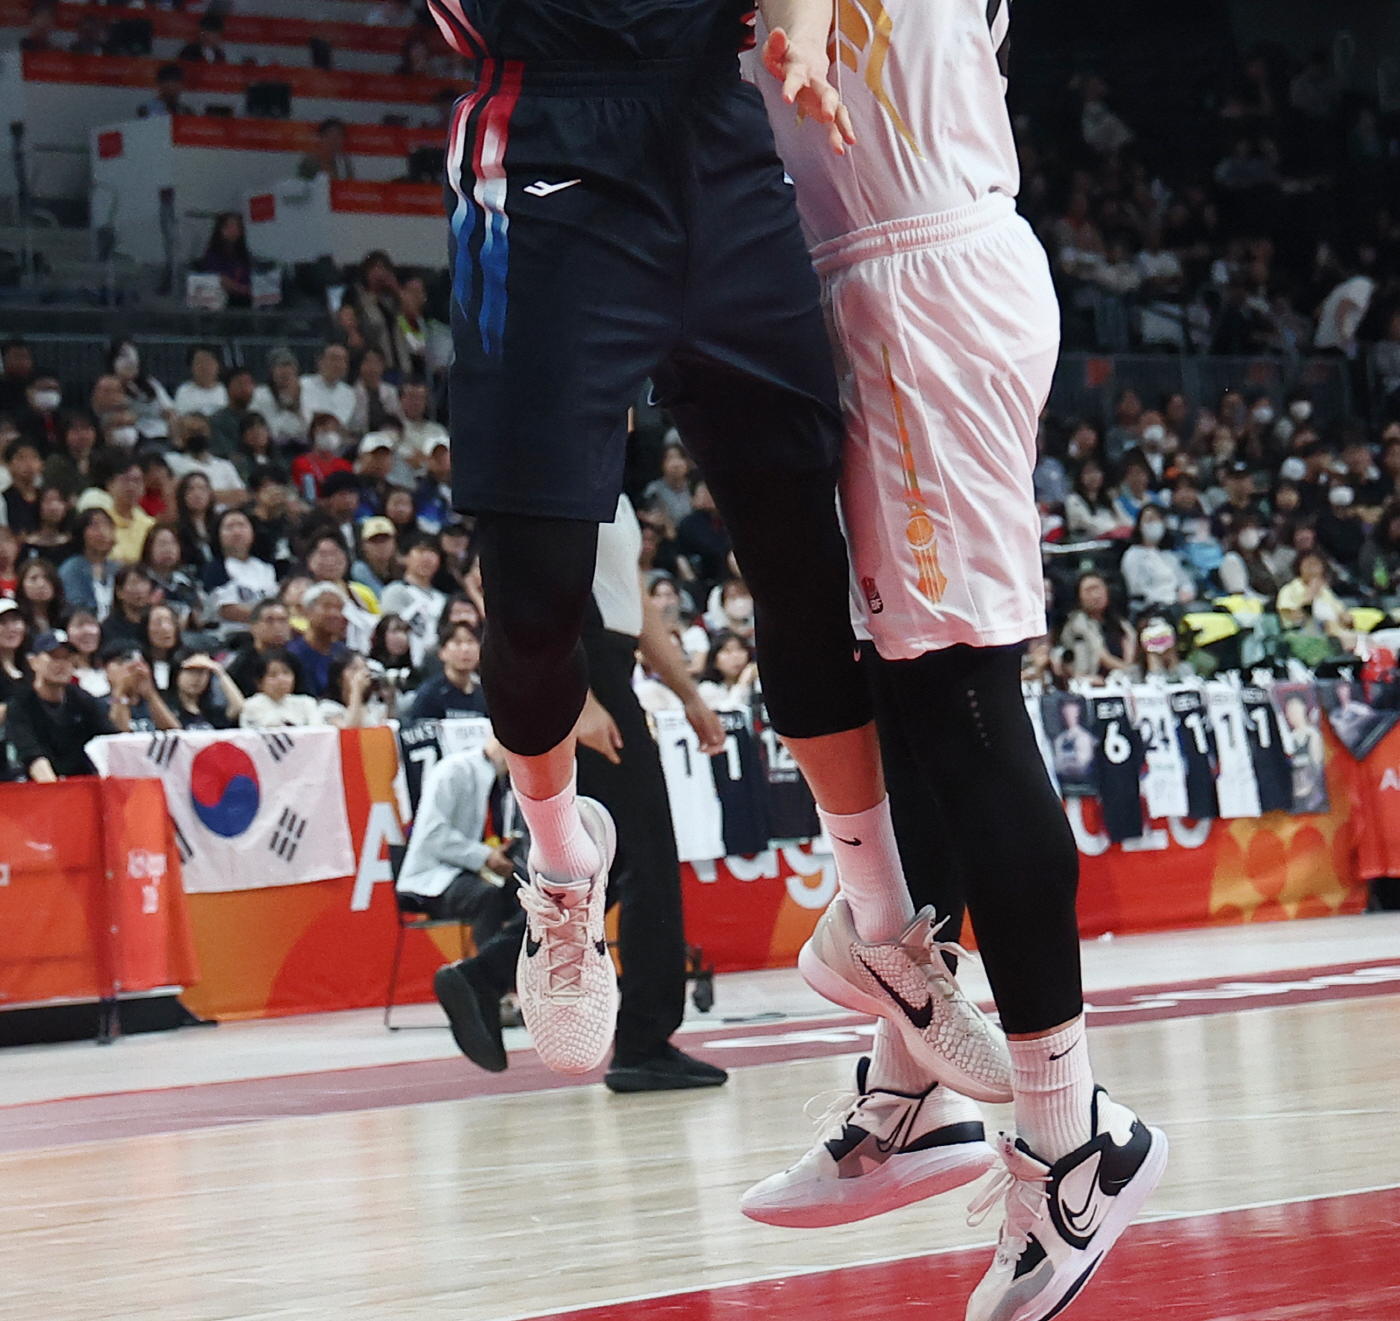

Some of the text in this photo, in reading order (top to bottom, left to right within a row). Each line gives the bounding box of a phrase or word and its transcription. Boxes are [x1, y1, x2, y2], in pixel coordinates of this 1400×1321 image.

[1104, 720, 1132, 764] 6
[1184, 712, 1209, 754] 1
[1220, 713, 1236, 748] 1
[1250, 706, 1272, 748] 1
[675, 738, 693, 778] 1
